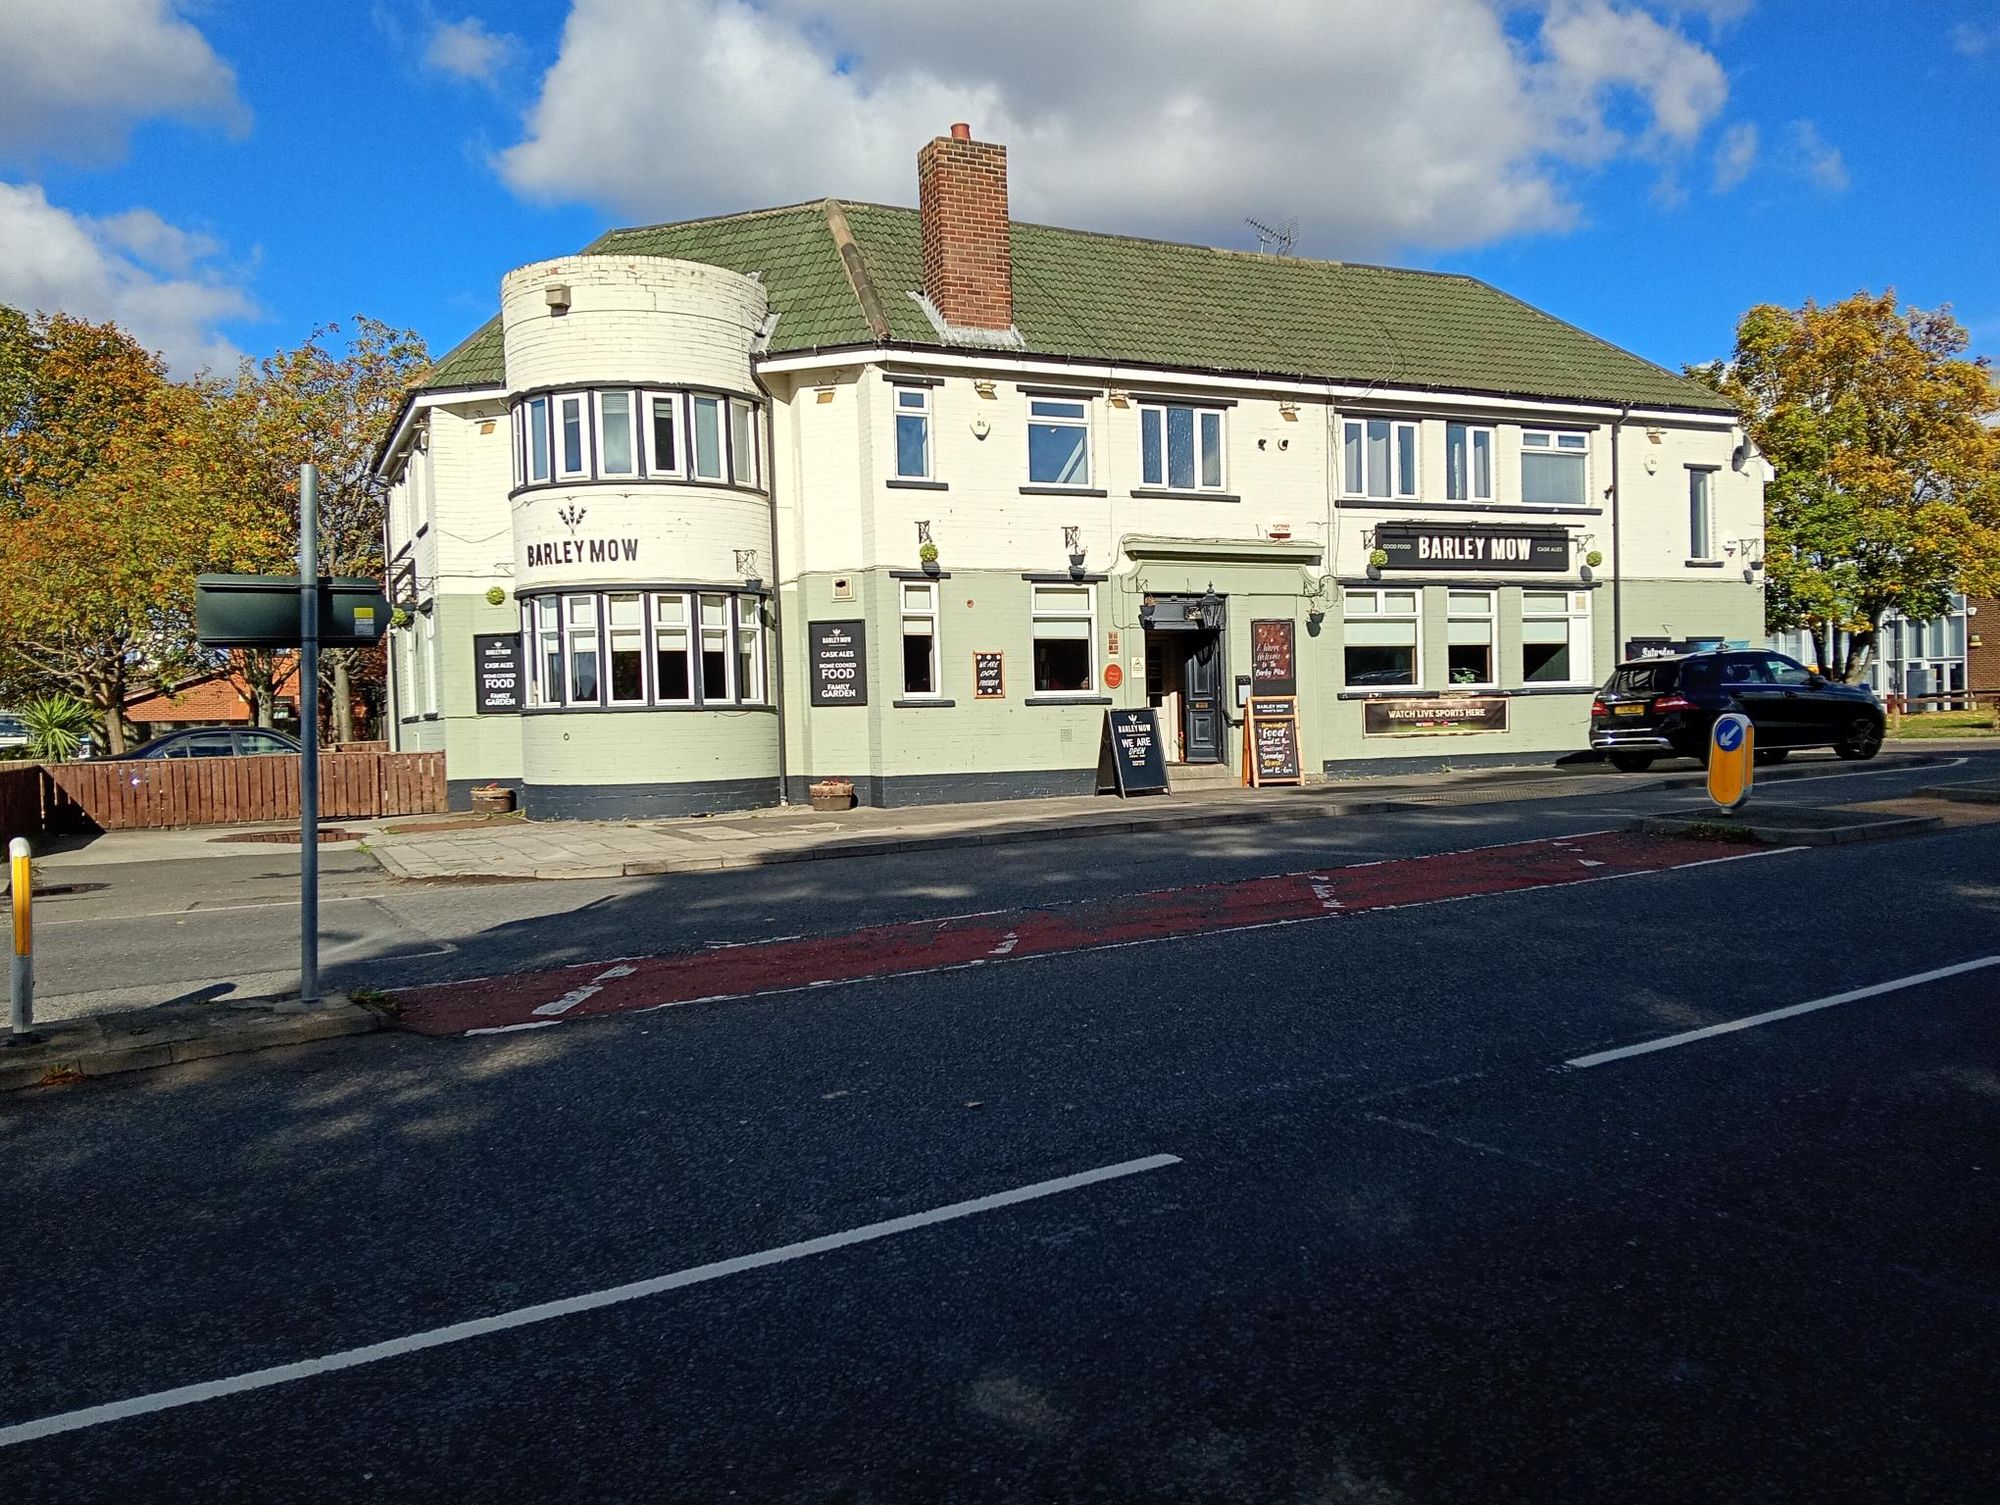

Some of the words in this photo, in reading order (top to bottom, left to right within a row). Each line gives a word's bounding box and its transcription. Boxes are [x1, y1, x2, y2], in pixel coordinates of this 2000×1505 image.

[527, 540, 584, 567] BARLEY
[589, 539, 638, 563] MOW
[1418, 536, 1484, 560] BARLEY
[1490, 537, 1531, 560] MOW
[822, 669, 855, 679] FOOD
[485, 680, 514, 688] FOOD
[1388, 709, 1415, 718] WATCH
[1417, 710, 1434, 718] LIVE
[1435, 708, 1464, 717] SPORTS
[1466, 708, 1486, 716] HERE
[1118, 724, 1138, 732] BARLEY
[1121, 738, 1134, 747] WE
[1137, 737, 1151, 746] ARE
[1128, 746, 1146, 755] OPEN
